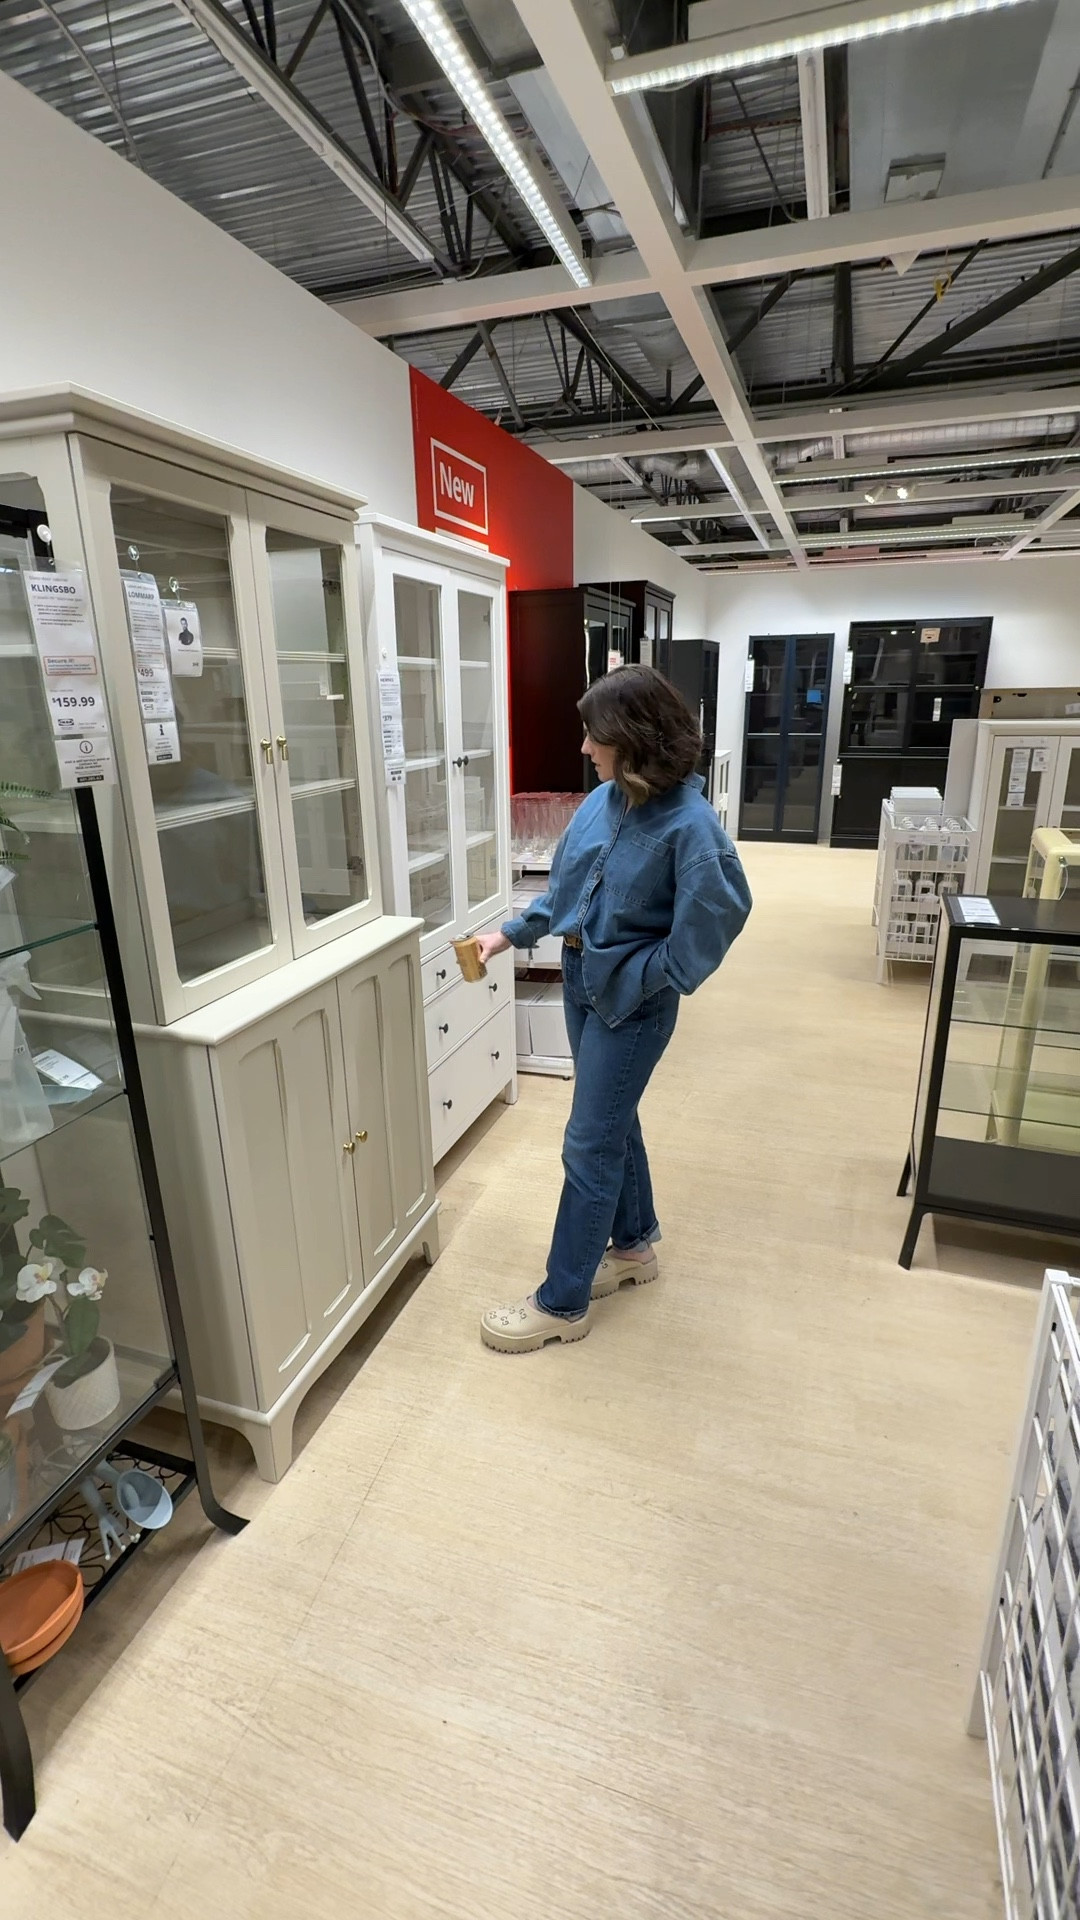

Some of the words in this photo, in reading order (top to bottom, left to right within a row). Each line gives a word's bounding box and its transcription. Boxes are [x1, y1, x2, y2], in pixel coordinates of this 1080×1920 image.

[440, 461, 474, 508] New
[31, 583, 76, 594] KLINGSBO
[138, 667, 154, 677] $499
[52, 696, 95, 707] $159.99
